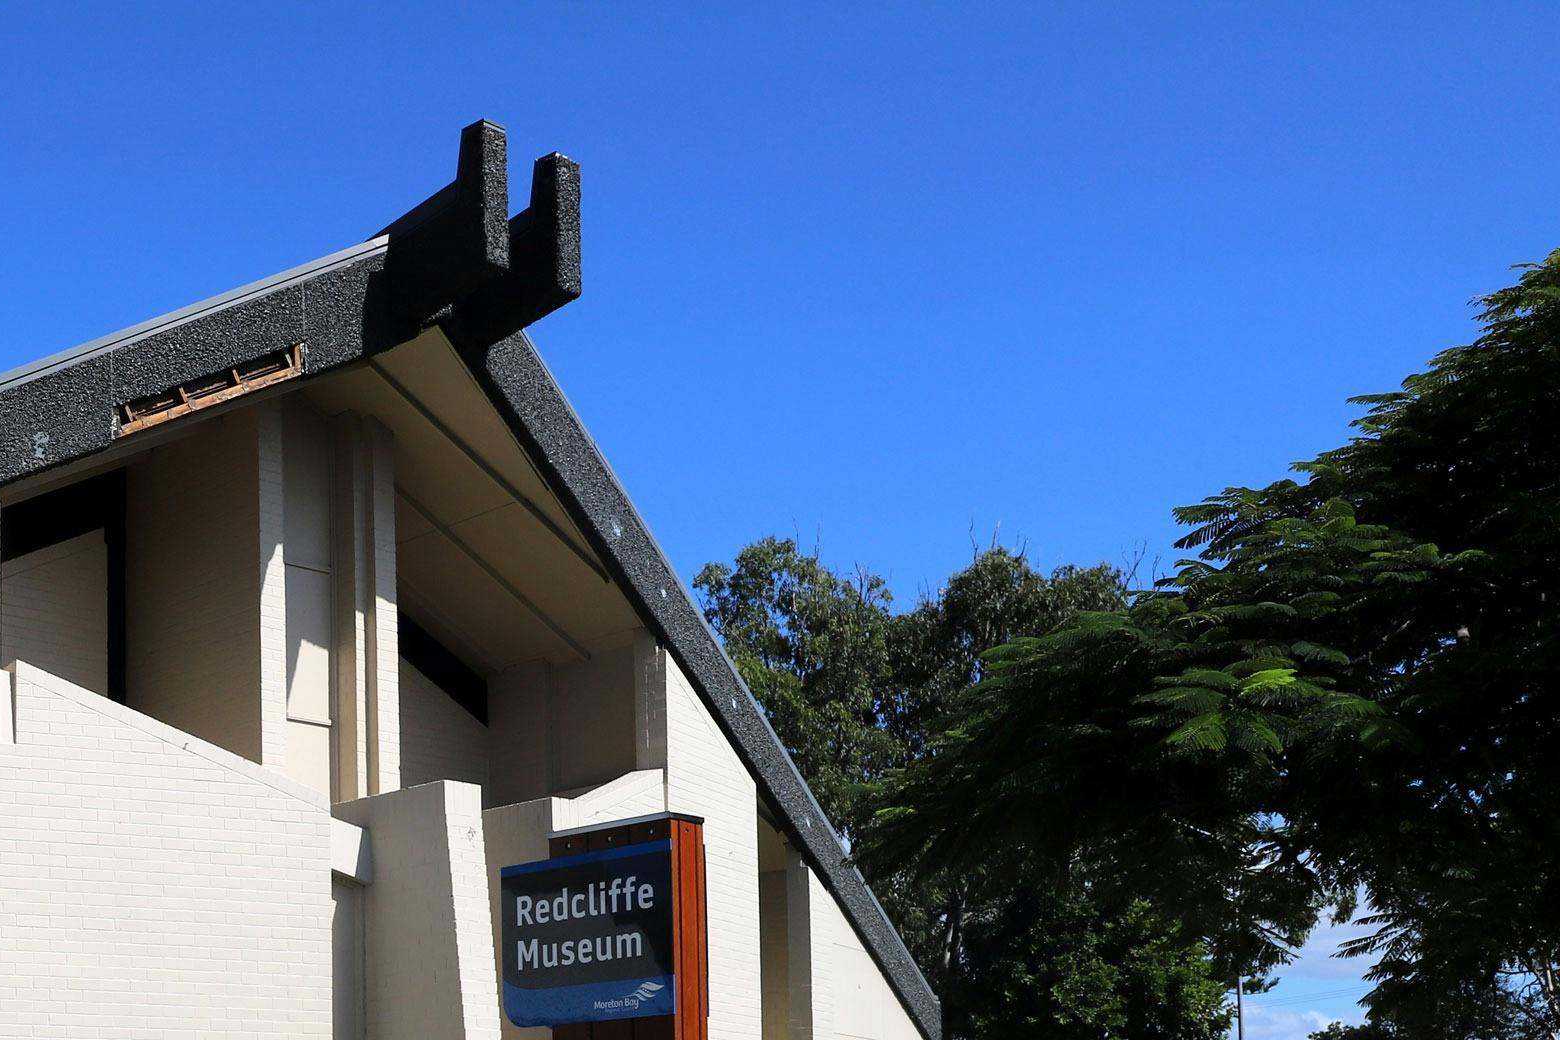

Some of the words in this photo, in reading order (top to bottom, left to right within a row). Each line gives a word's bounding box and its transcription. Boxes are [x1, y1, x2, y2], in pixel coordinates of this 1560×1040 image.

[516, 876, 654, 927] Redcliffe
[517, 932, 642, 971] Museum
[594, 999, 624, 1009] Moreton
[624, 998, 639, 1009] Bay
